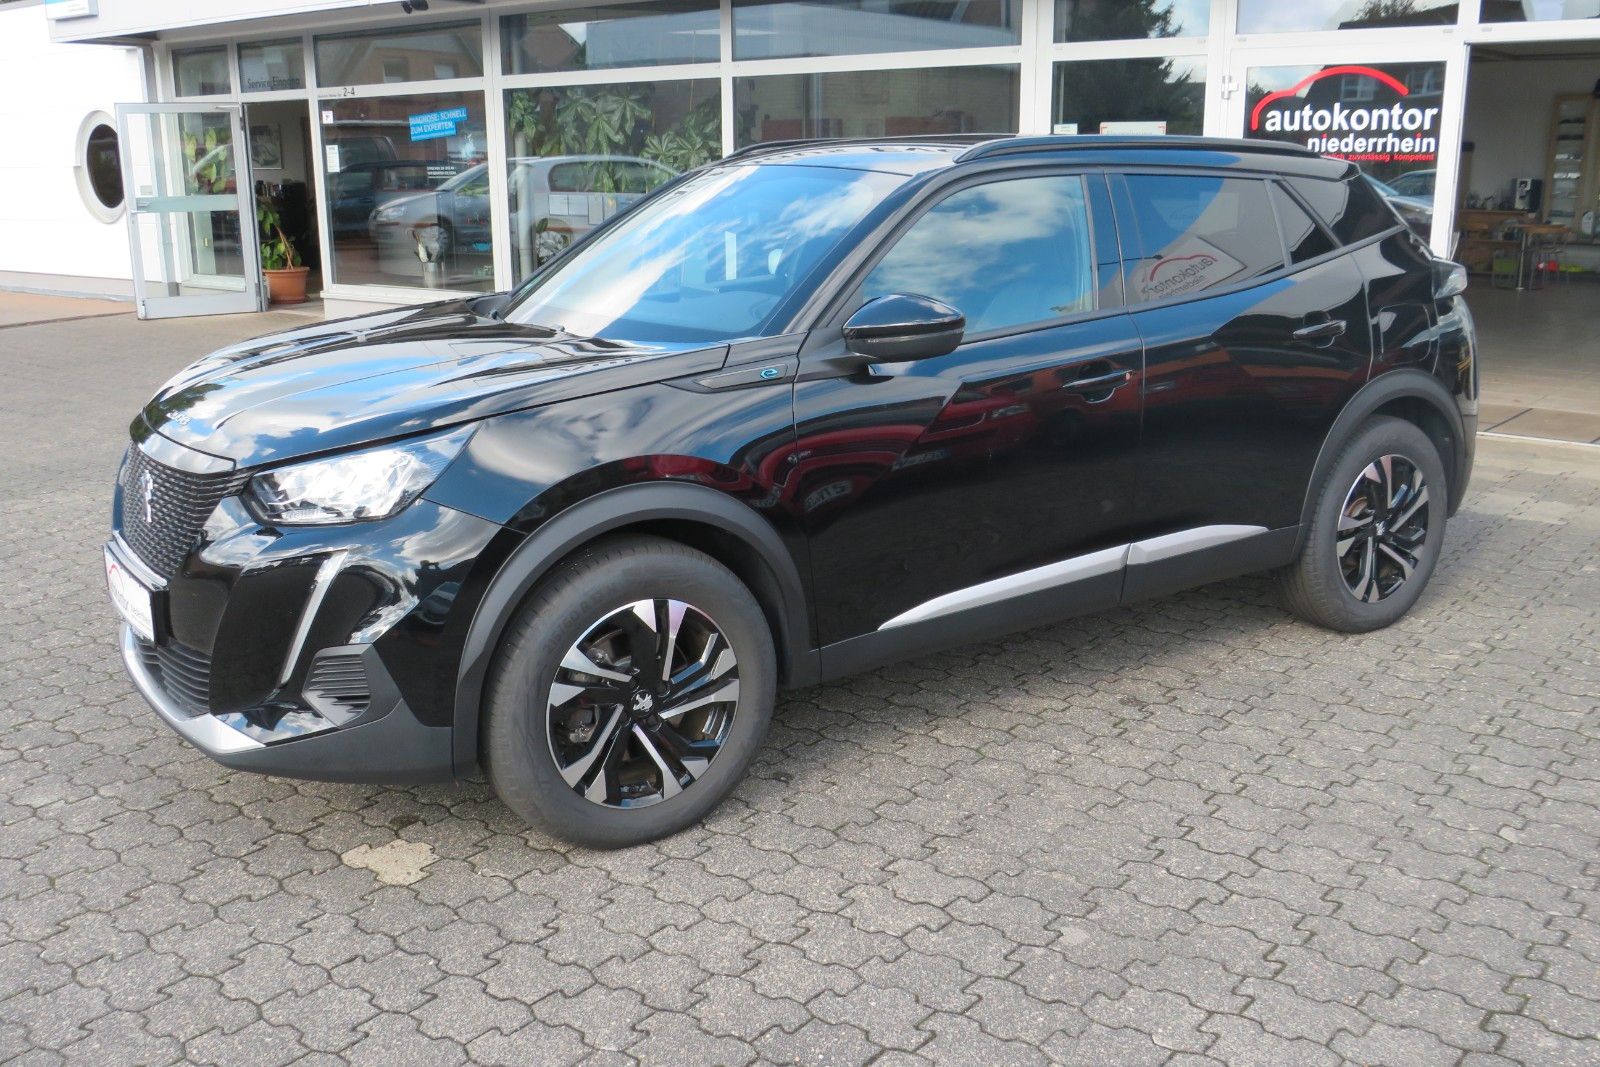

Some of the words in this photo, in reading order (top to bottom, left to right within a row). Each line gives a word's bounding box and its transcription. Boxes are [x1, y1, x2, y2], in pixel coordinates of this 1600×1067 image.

[343, 87, 355, 97] 2-4
[440, 109, 467, 120] SCHNELL
[1264, 102, 1438, 132] autokontor
[411, 126, 424, 134] ZUM
[1307, 132, 1436, 153] niederrhein
[1348, 152, 1391, 162] zuverlässig
[1393, 152, 1435, 162] kompetent
